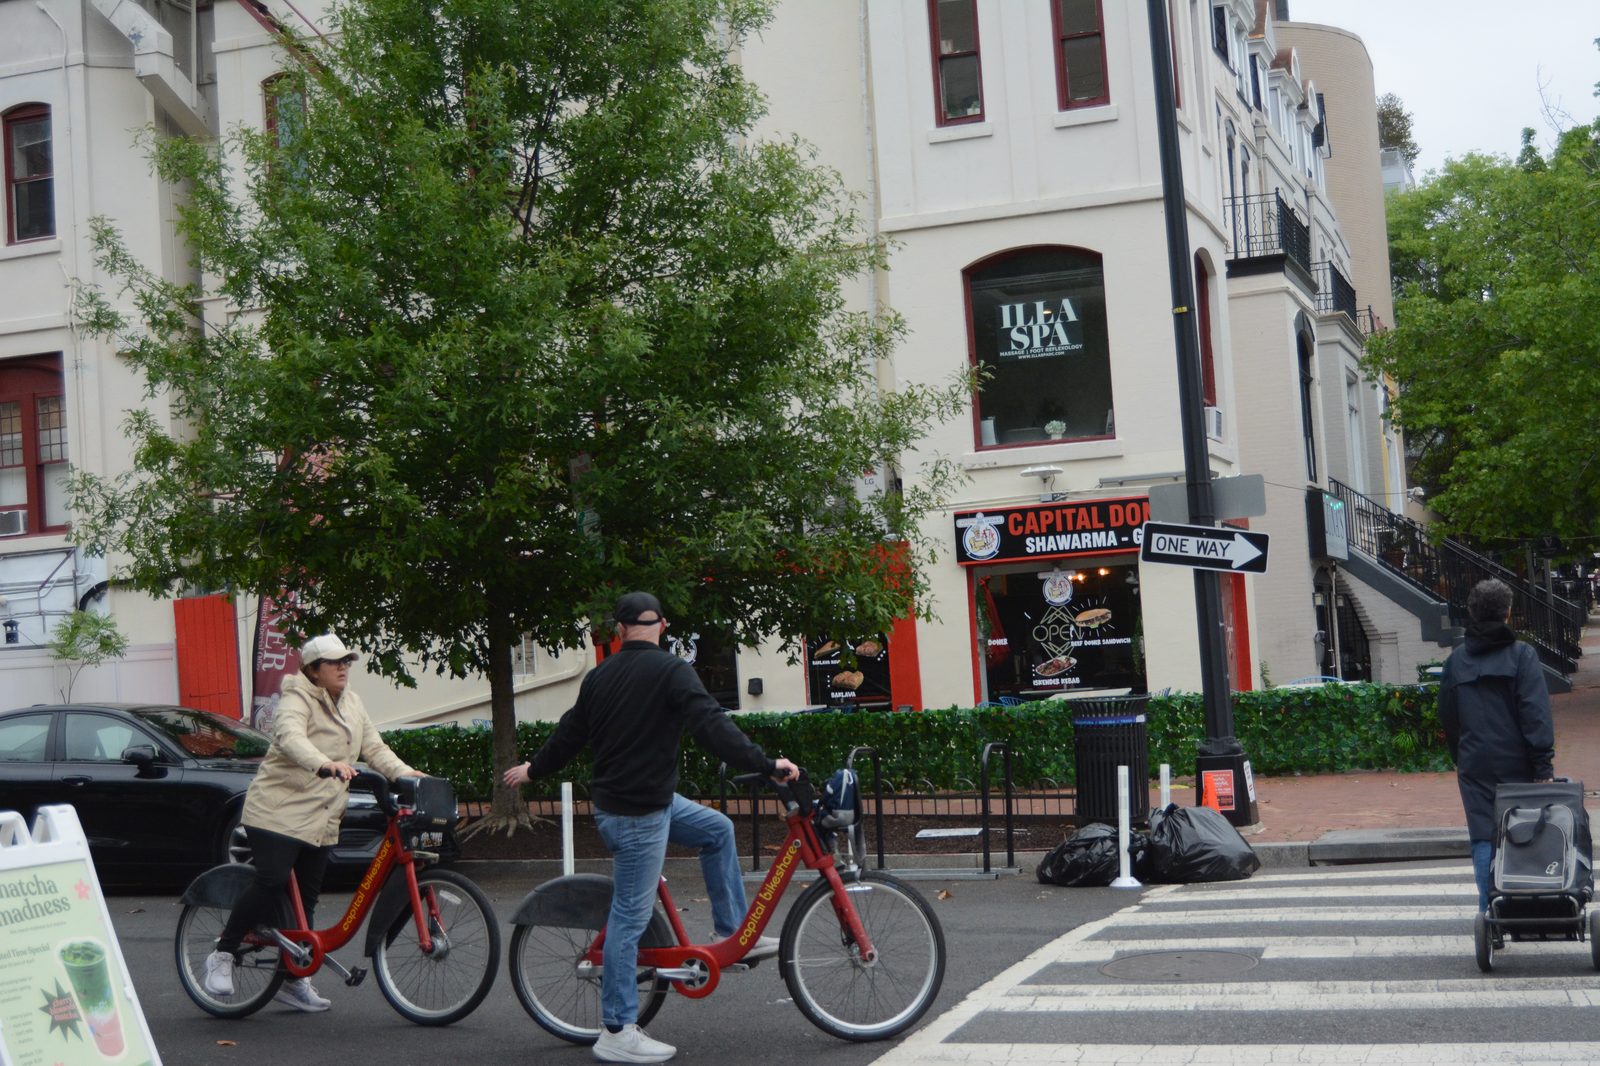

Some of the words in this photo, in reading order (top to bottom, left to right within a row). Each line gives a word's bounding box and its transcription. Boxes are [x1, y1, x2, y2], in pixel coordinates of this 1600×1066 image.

[1000, 298, 1080, 329] ILLA
[1010, 322, 1072, 350] SPA
[1045, 344, 1083, 352] REFLEXOLOGY
[1008, 506, 1104, 536] CAPITAL
[1025, 530, 1118, 553] SHAWARMA
[1156, 536, 1189, 553] ONE
[1196, 539, 1231, 557] WAY
[987, 638, 1009, 646] DONER
[1032, 624, 1083, 642] OPEN
[342, 891, 366, 931] capital
[361, 839, 392, 890] bikeshare
[739, 901, 766, 945] capital
[759, 845, 797, 901] bikeshare
